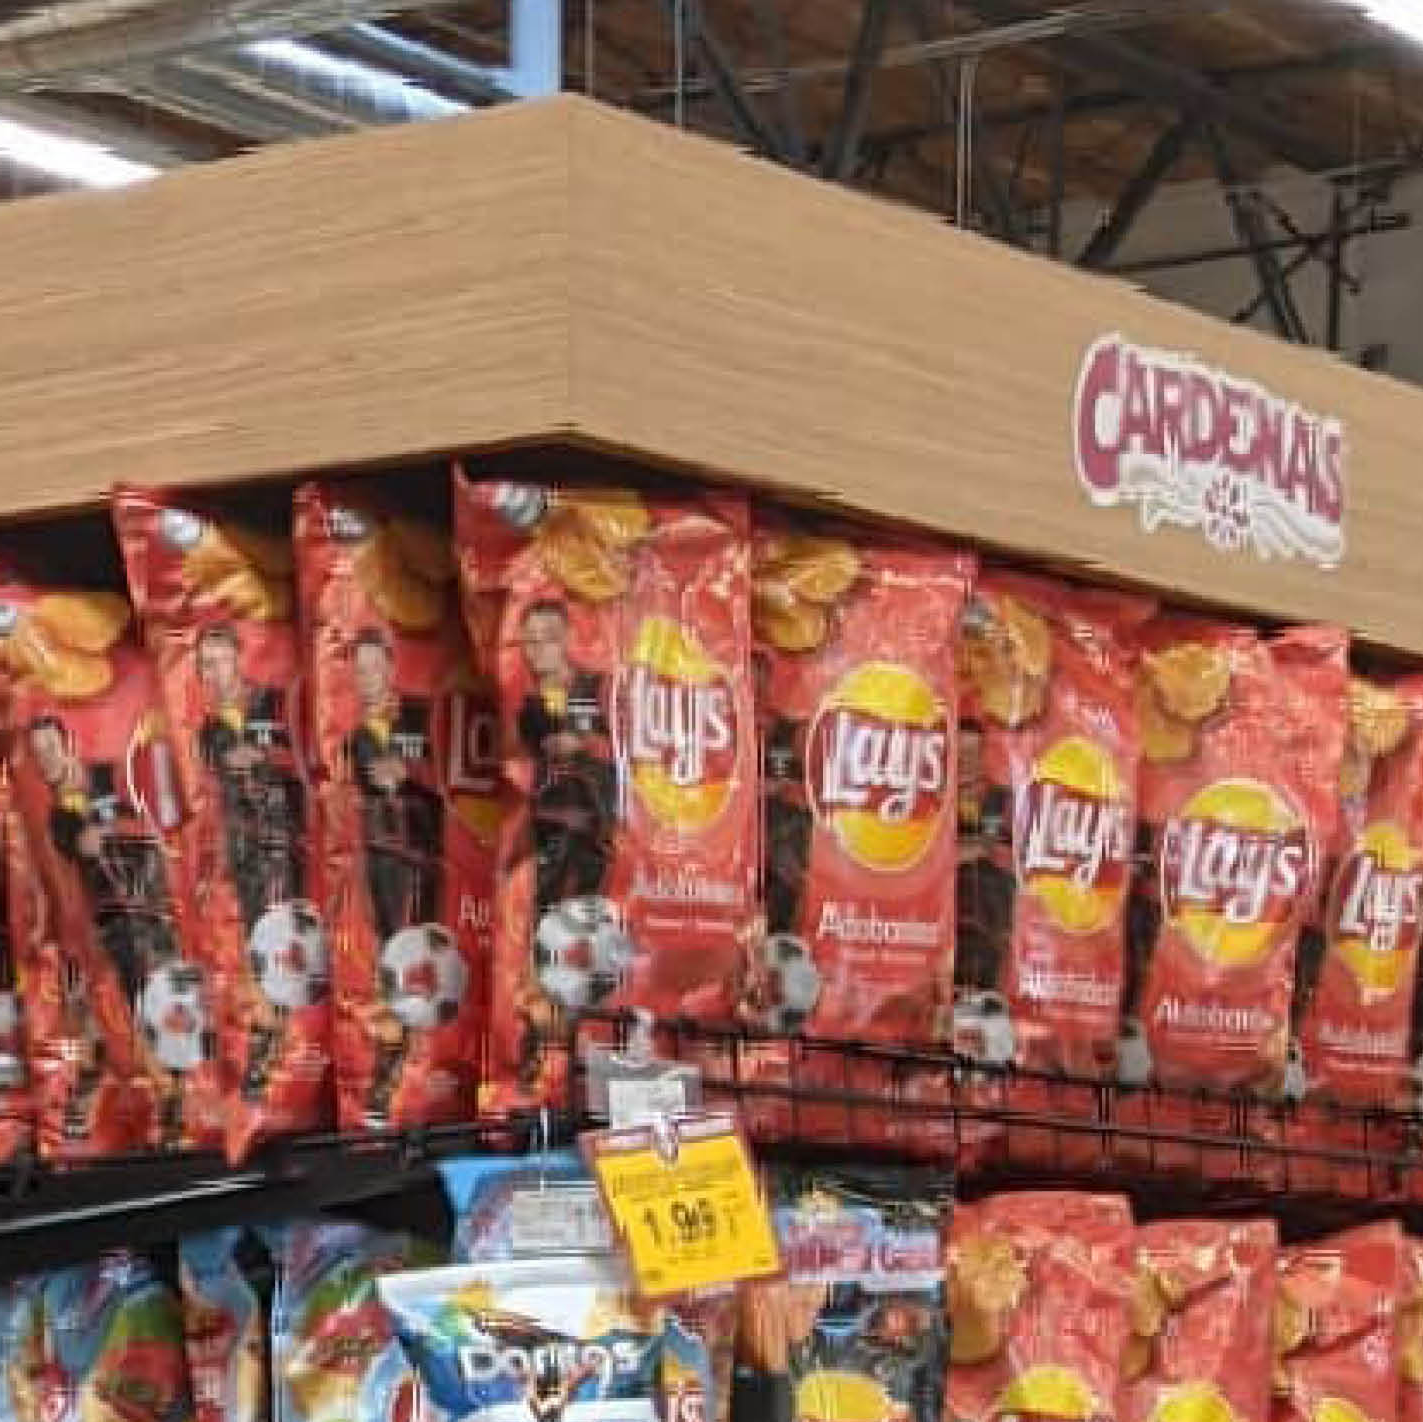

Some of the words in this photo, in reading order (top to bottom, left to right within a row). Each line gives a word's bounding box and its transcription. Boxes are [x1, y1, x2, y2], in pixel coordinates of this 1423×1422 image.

[1078, 342, 1344, 524] CARDENAS
[628, 664, 732, 786] Lay's
[821, 706, 946, 820] Lay's
[1176, 818, 1314, 924] Lay's
[458, 1338, 641, 1386] Doritos
